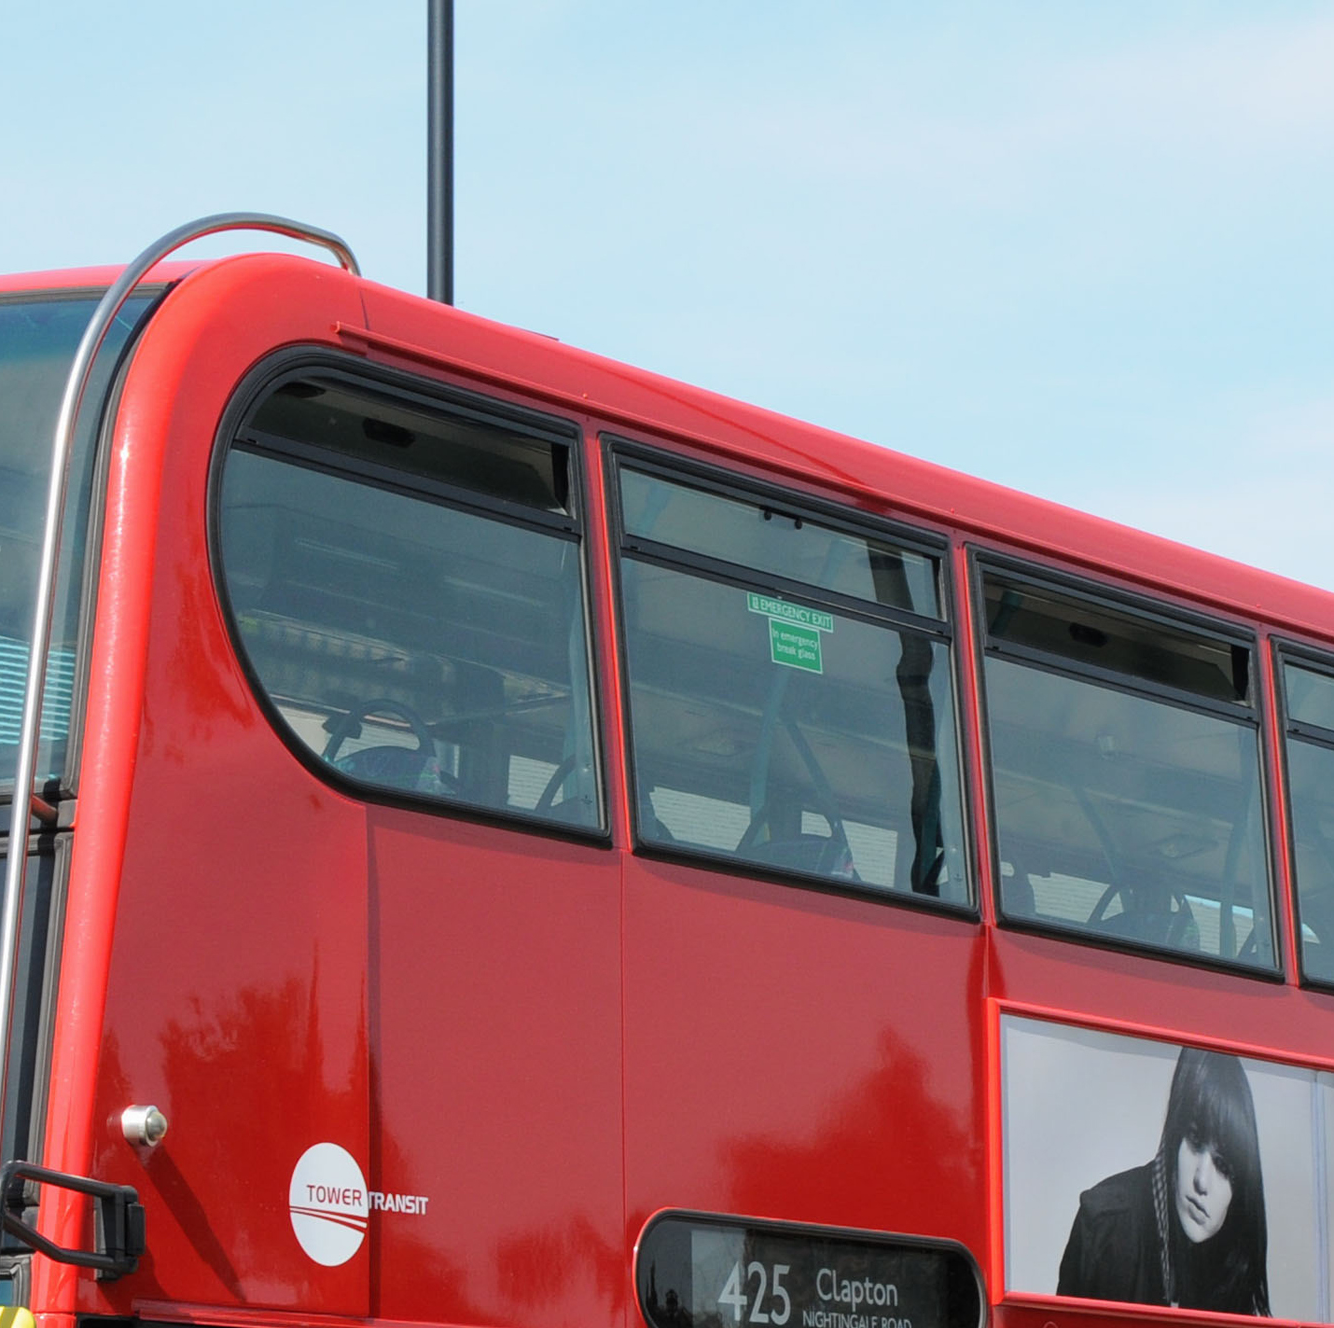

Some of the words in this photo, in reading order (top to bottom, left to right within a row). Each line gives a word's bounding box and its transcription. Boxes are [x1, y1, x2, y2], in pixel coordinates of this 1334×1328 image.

[306, 1184, 362, 1207] TOWER
[367, 1191, 429, 1215] TRANSIT
[718, 1260, 791, 1326] 425
[816, 1268, 898, 1312] Clapton
